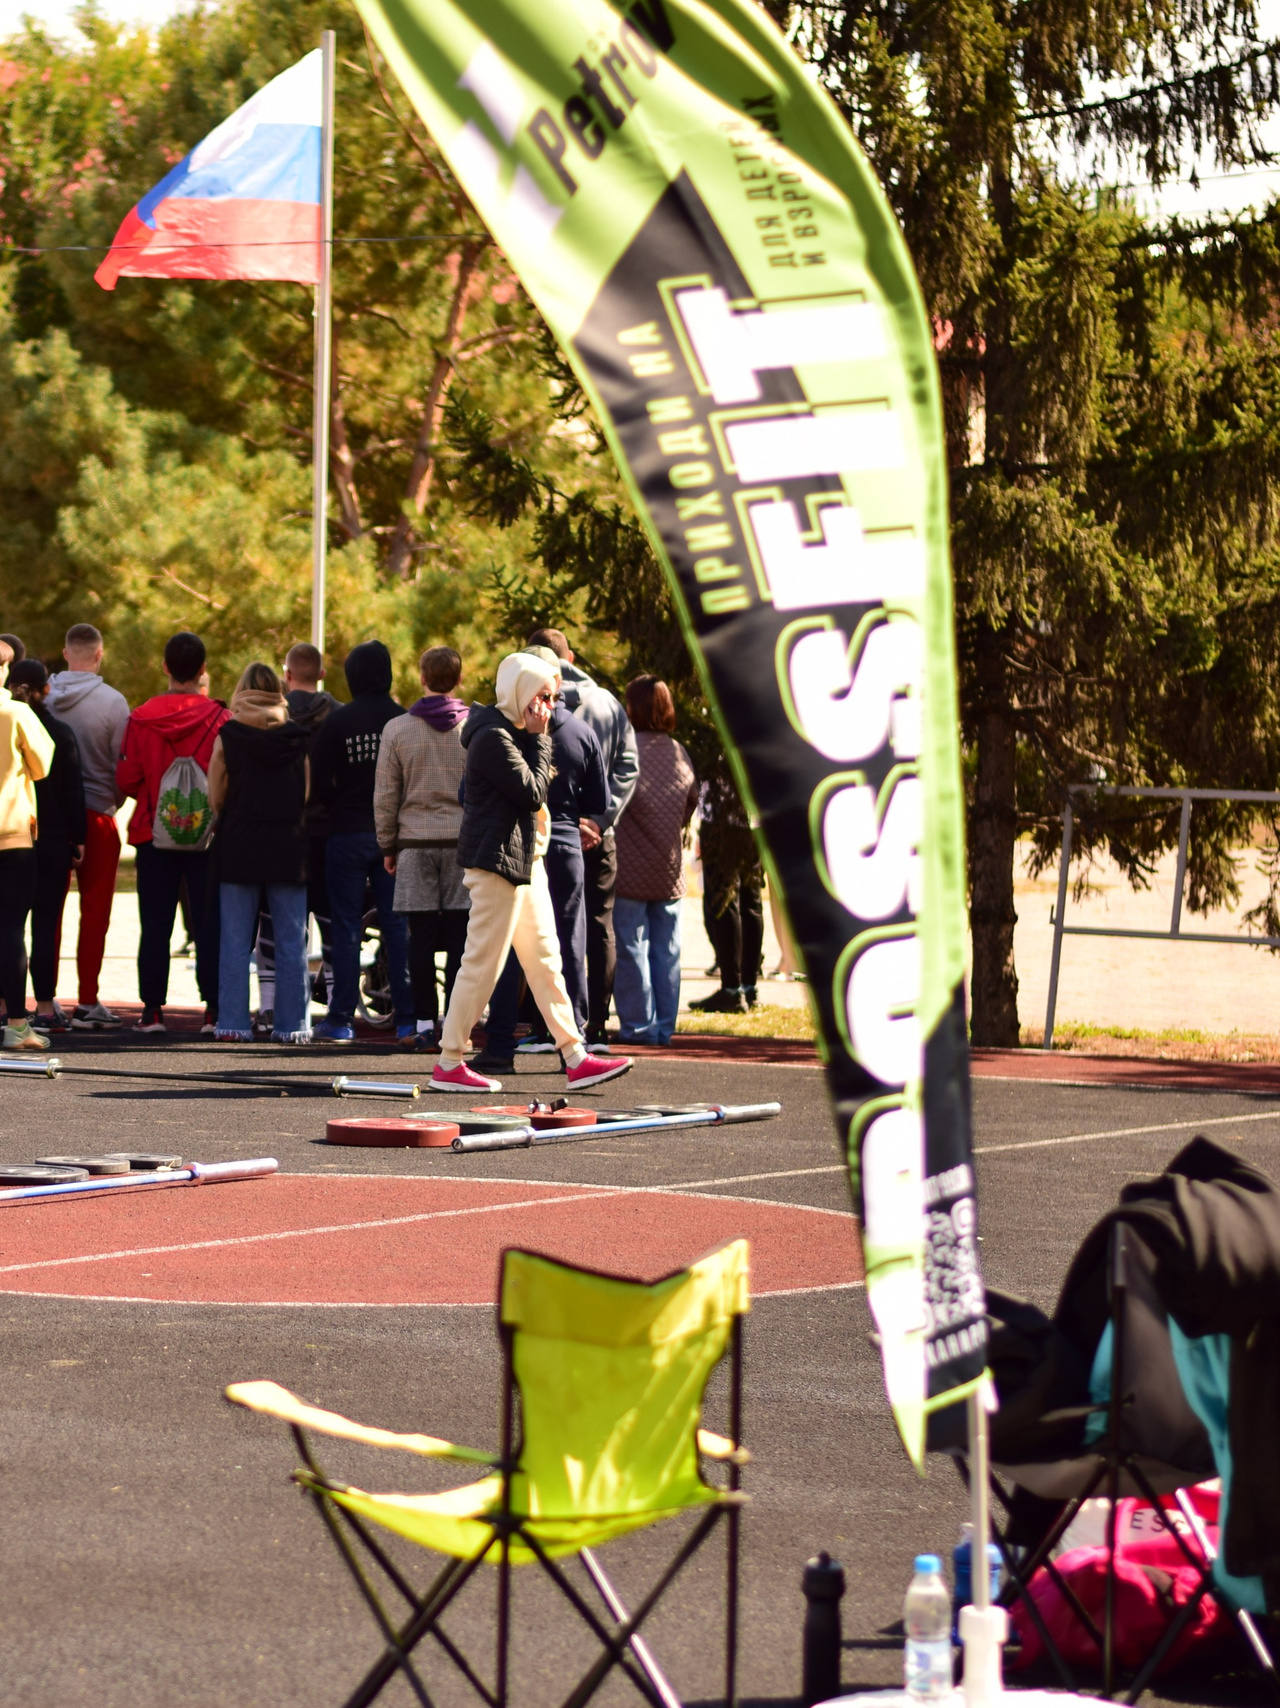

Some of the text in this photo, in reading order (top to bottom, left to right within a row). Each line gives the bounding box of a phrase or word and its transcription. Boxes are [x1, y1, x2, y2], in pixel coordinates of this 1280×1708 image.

[527, 0, 676, 198] Petrov
[755, 215, 800, 268] ДЛЯ
[801, 252, 827, 266] И
[617, 320, 750, 614] ПРИХОДИ НА
